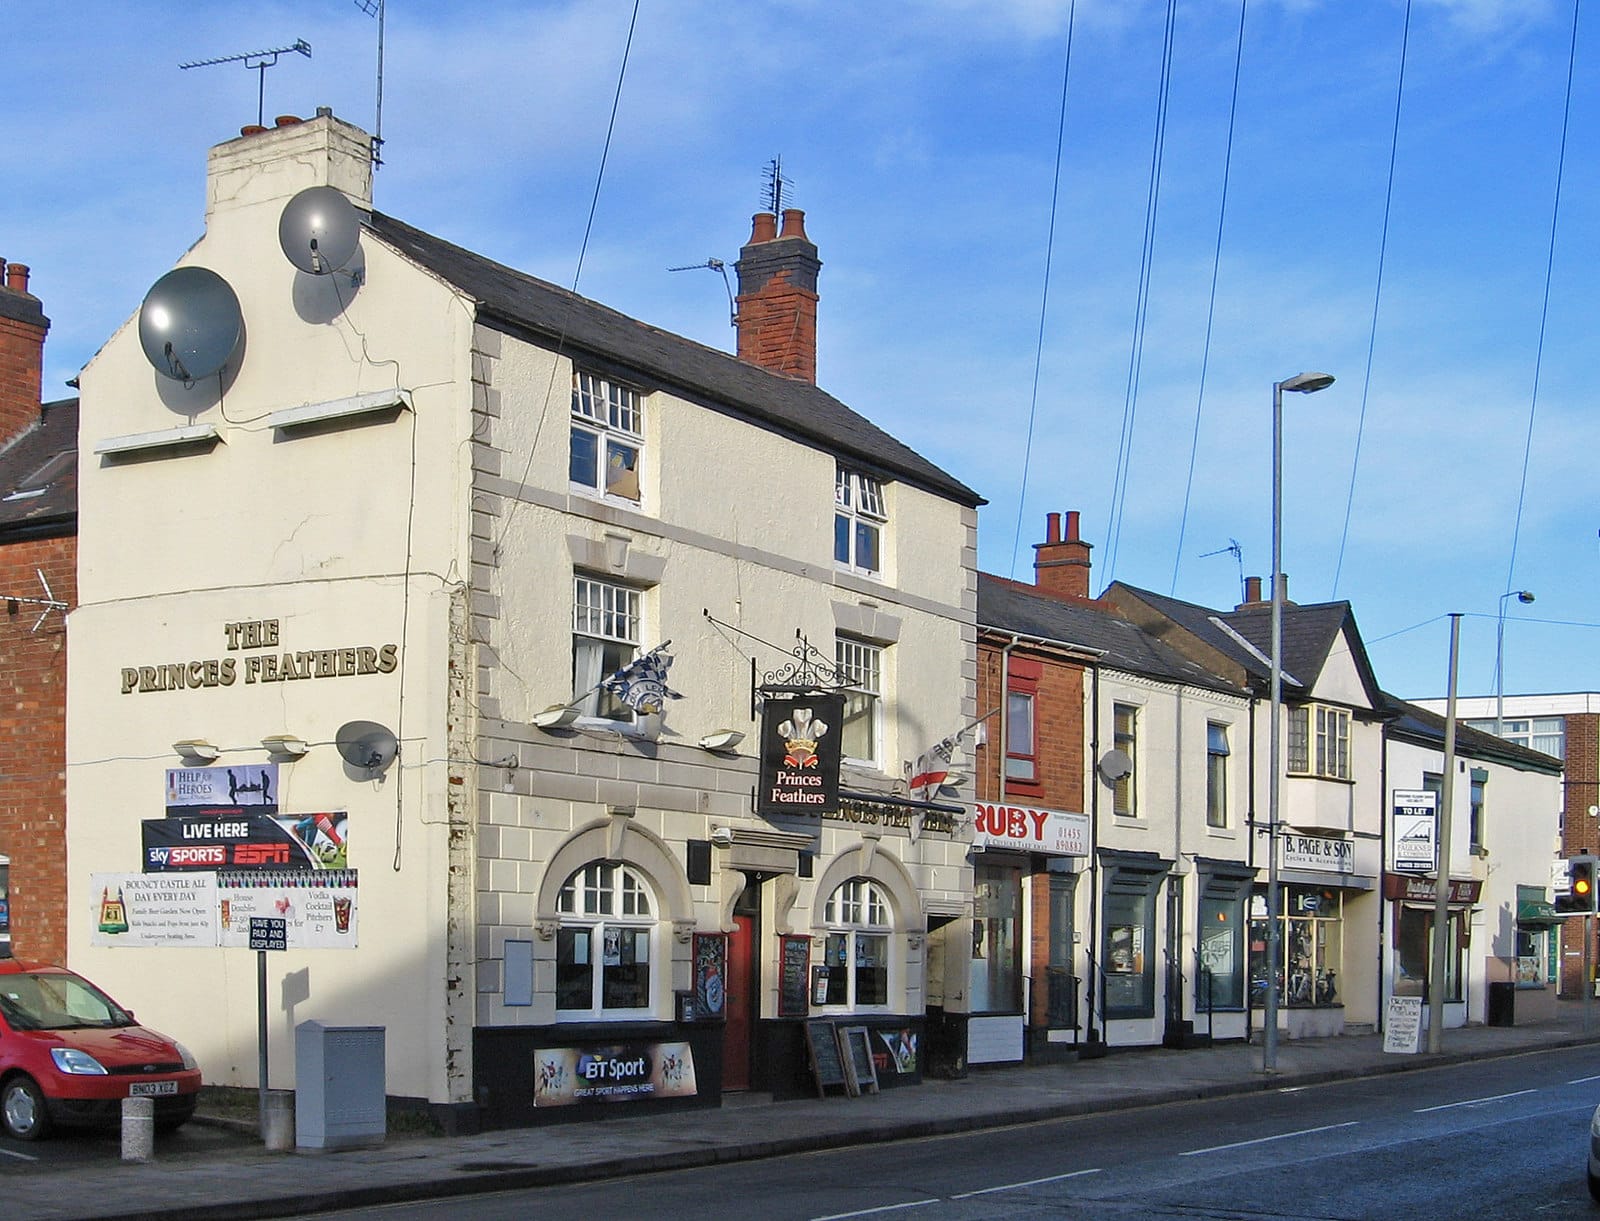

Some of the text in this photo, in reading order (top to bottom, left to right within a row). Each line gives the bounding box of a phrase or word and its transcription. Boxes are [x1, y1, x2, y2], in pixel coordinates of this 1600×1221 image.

[225, 619, 279, 650] THE
[121, 644, 398, 694] PRINCES FEATHERS
[179, 772, 201, 782] HELP
[776, 771, 822, 786] Princes
[179, 784, 212, 795] HEROES
[771, 788, 826, 804] Feathers
[1403, 807, 1428, 816] TO LET
[975, 803, 1049, 841] RUBY
[183, 822, 249, 839] LIVE HERE
[1286, 836, 1352, 859] B. PAGE & SON
[150, 843, 291, 865] sky SPORTS ESPN
[126, 879, 206, 889] BOUNCY CASTLE ALL
[135, 892, 197, 901] DAY EVERY DAY
[309, 891, 330, 899] Vodka
[306, 902, 332, 911] Cocktail
[306, 913, 333, 921] Pitchers
[252, 919, 269, 928] HAVE
[270, 919, 284, 928] YOU
[252, 929, 267, 938] PAID
[270, 930, 283, 939] AND
[251, 940, 285, 949] DISPLAYED
[586, 1057, 645, 1080] BT Sport
[574, 1088, 595, 1097] GREAT
[596, 1086, 613, 1096] SPORT
[640, 1083, 655, 1092] HERE
